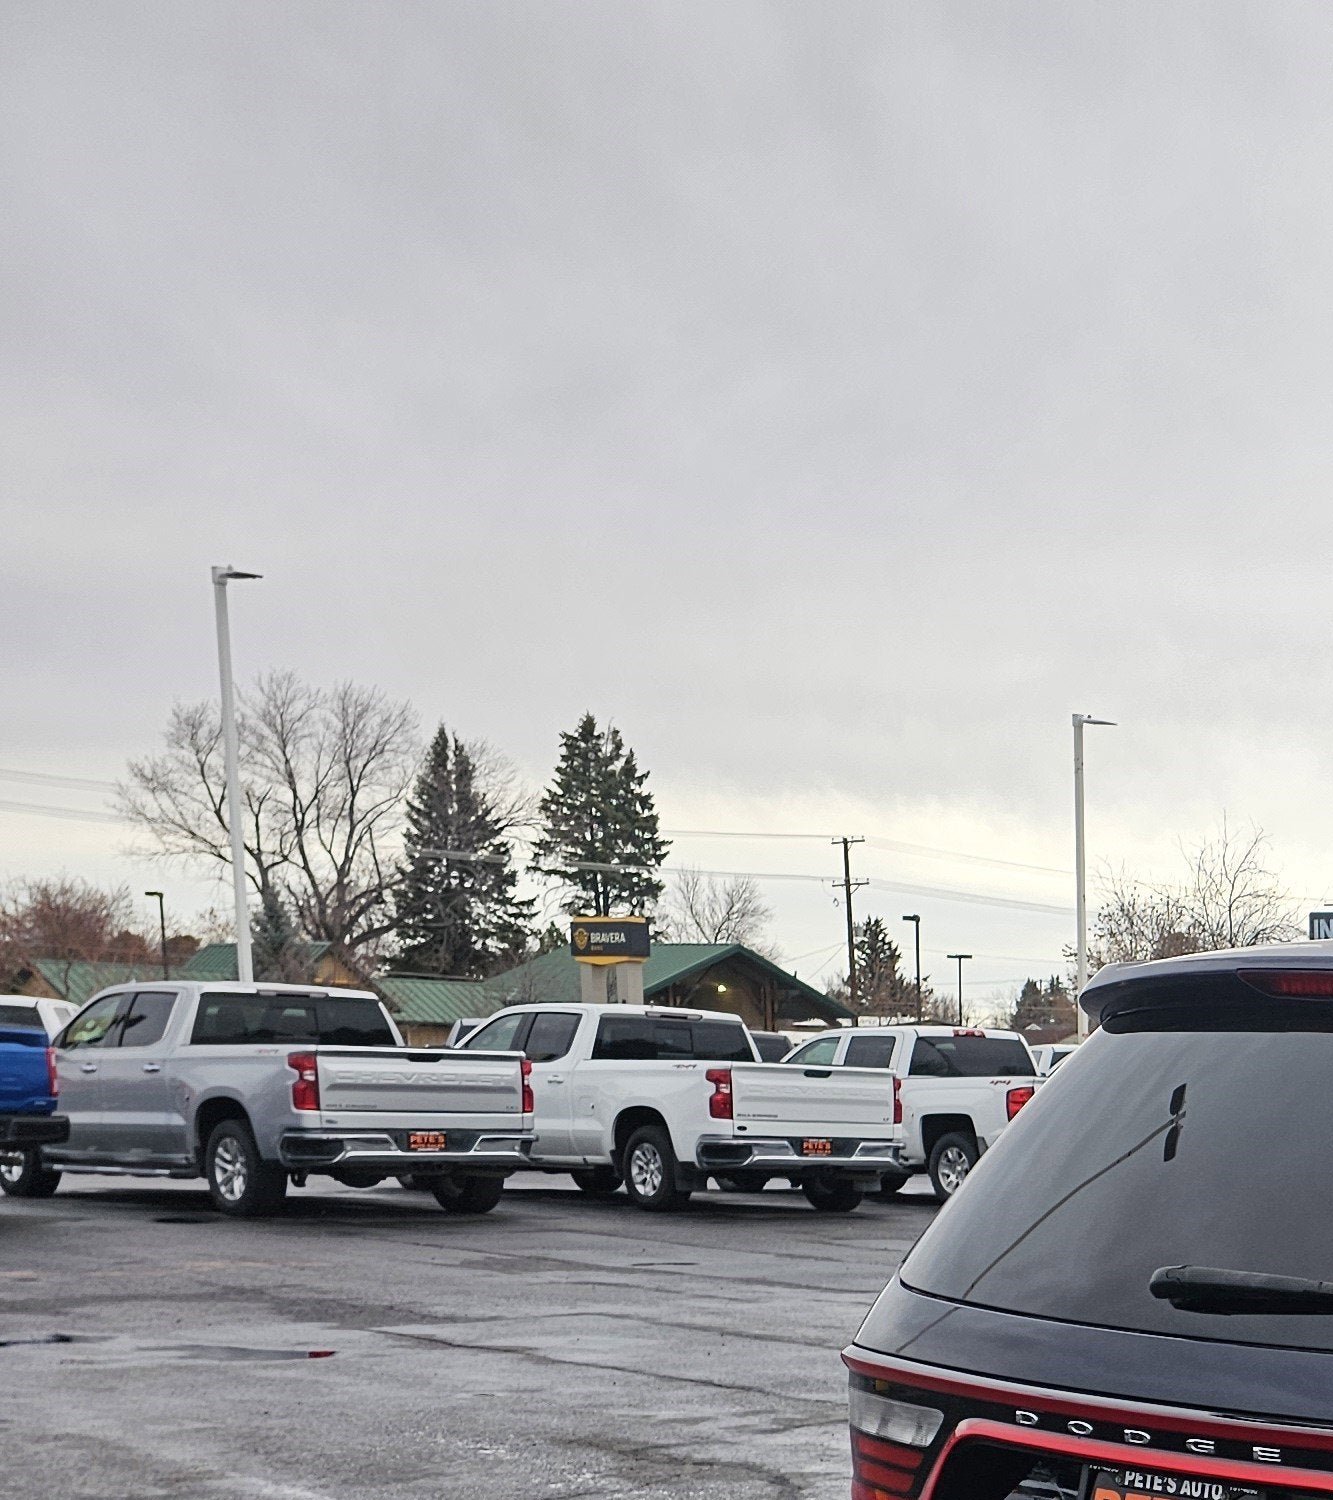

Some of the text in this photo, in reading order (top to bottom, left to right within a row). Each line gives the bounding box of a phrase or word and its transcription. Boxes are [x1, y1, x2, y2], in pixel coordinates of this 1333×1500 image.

[590, 932, 626, 943] BRAVERA
[1016, 1410, 1281, 1463] DODGE
[1124, 1470, 1223, 1500] PETE'S AUTO
